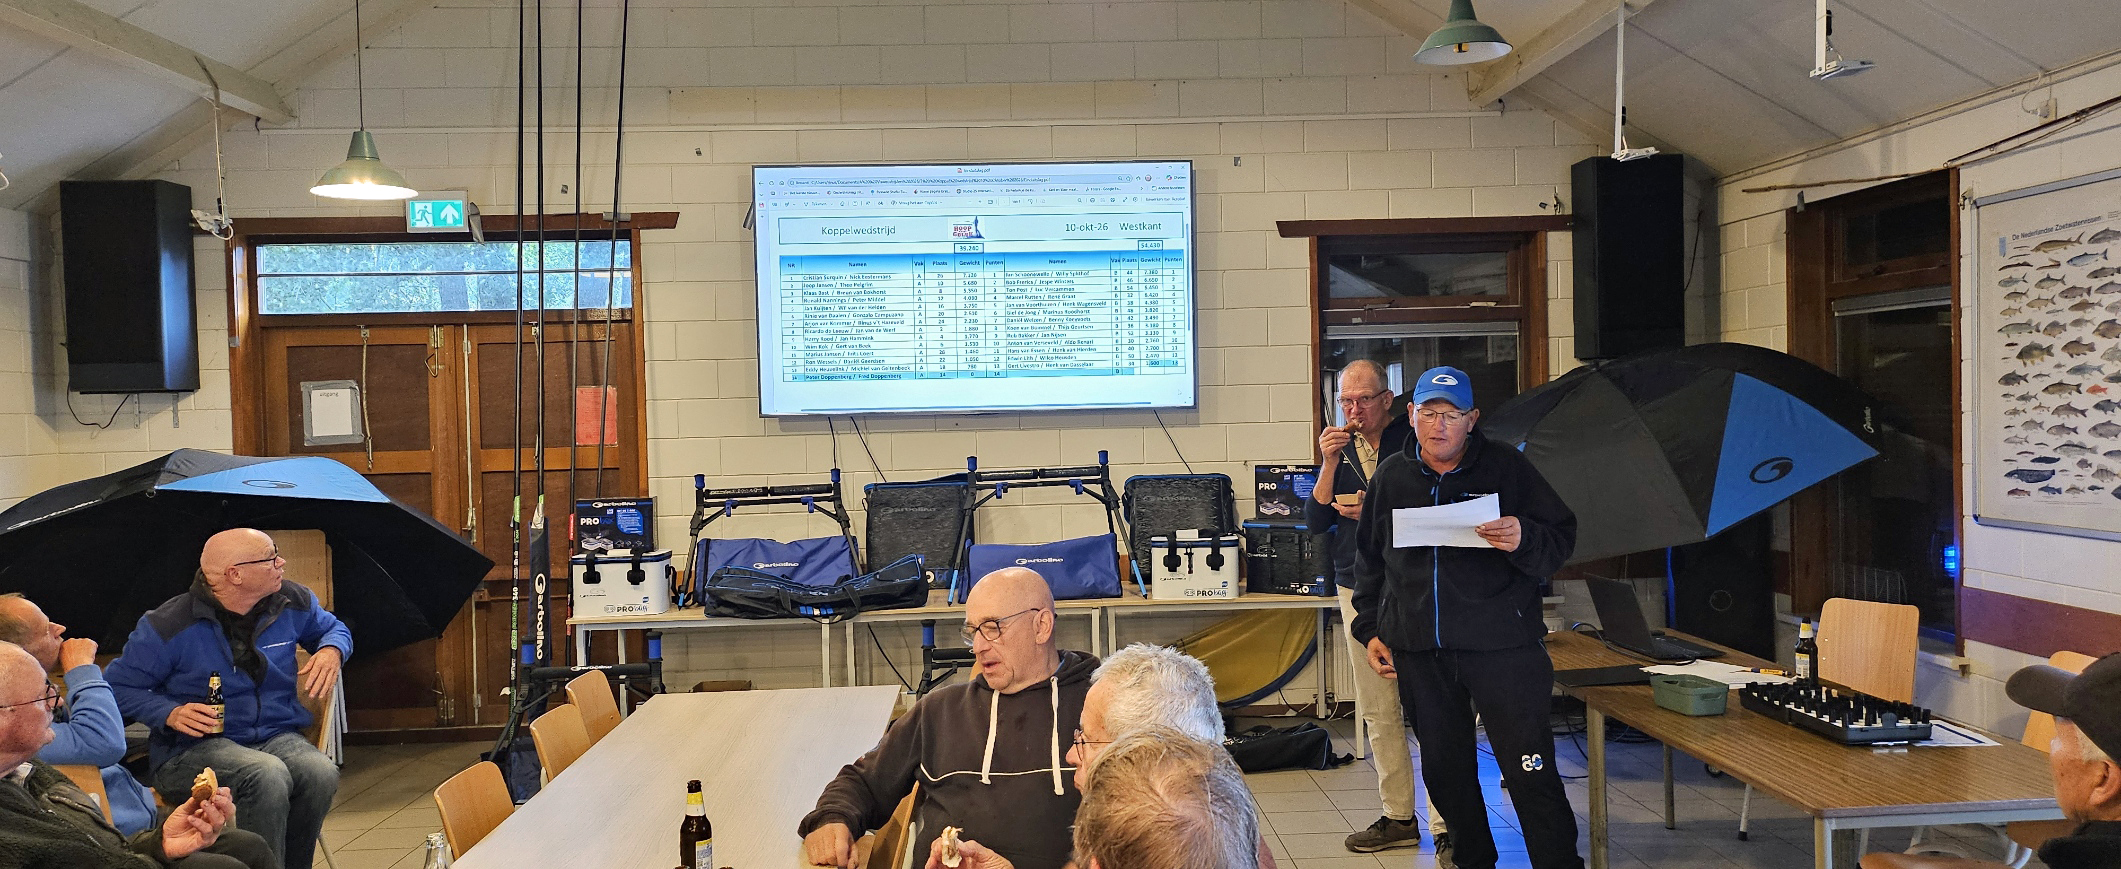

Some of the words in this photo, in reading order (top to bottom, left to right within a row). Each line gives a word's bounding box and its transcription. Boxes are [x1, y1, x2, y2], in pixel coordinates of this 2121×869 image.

[822, 226, 896, 236] Koppelwedstrijd
[1066, 222, 1108, 232] 10-okt-26
[1120, 221, 1162, 231] Westkant
[2021, 227, 2054, 238] Nederlandse
[753, 561, 799, 569] Garbolino
[535, 573, 546, 660] Garbolino
